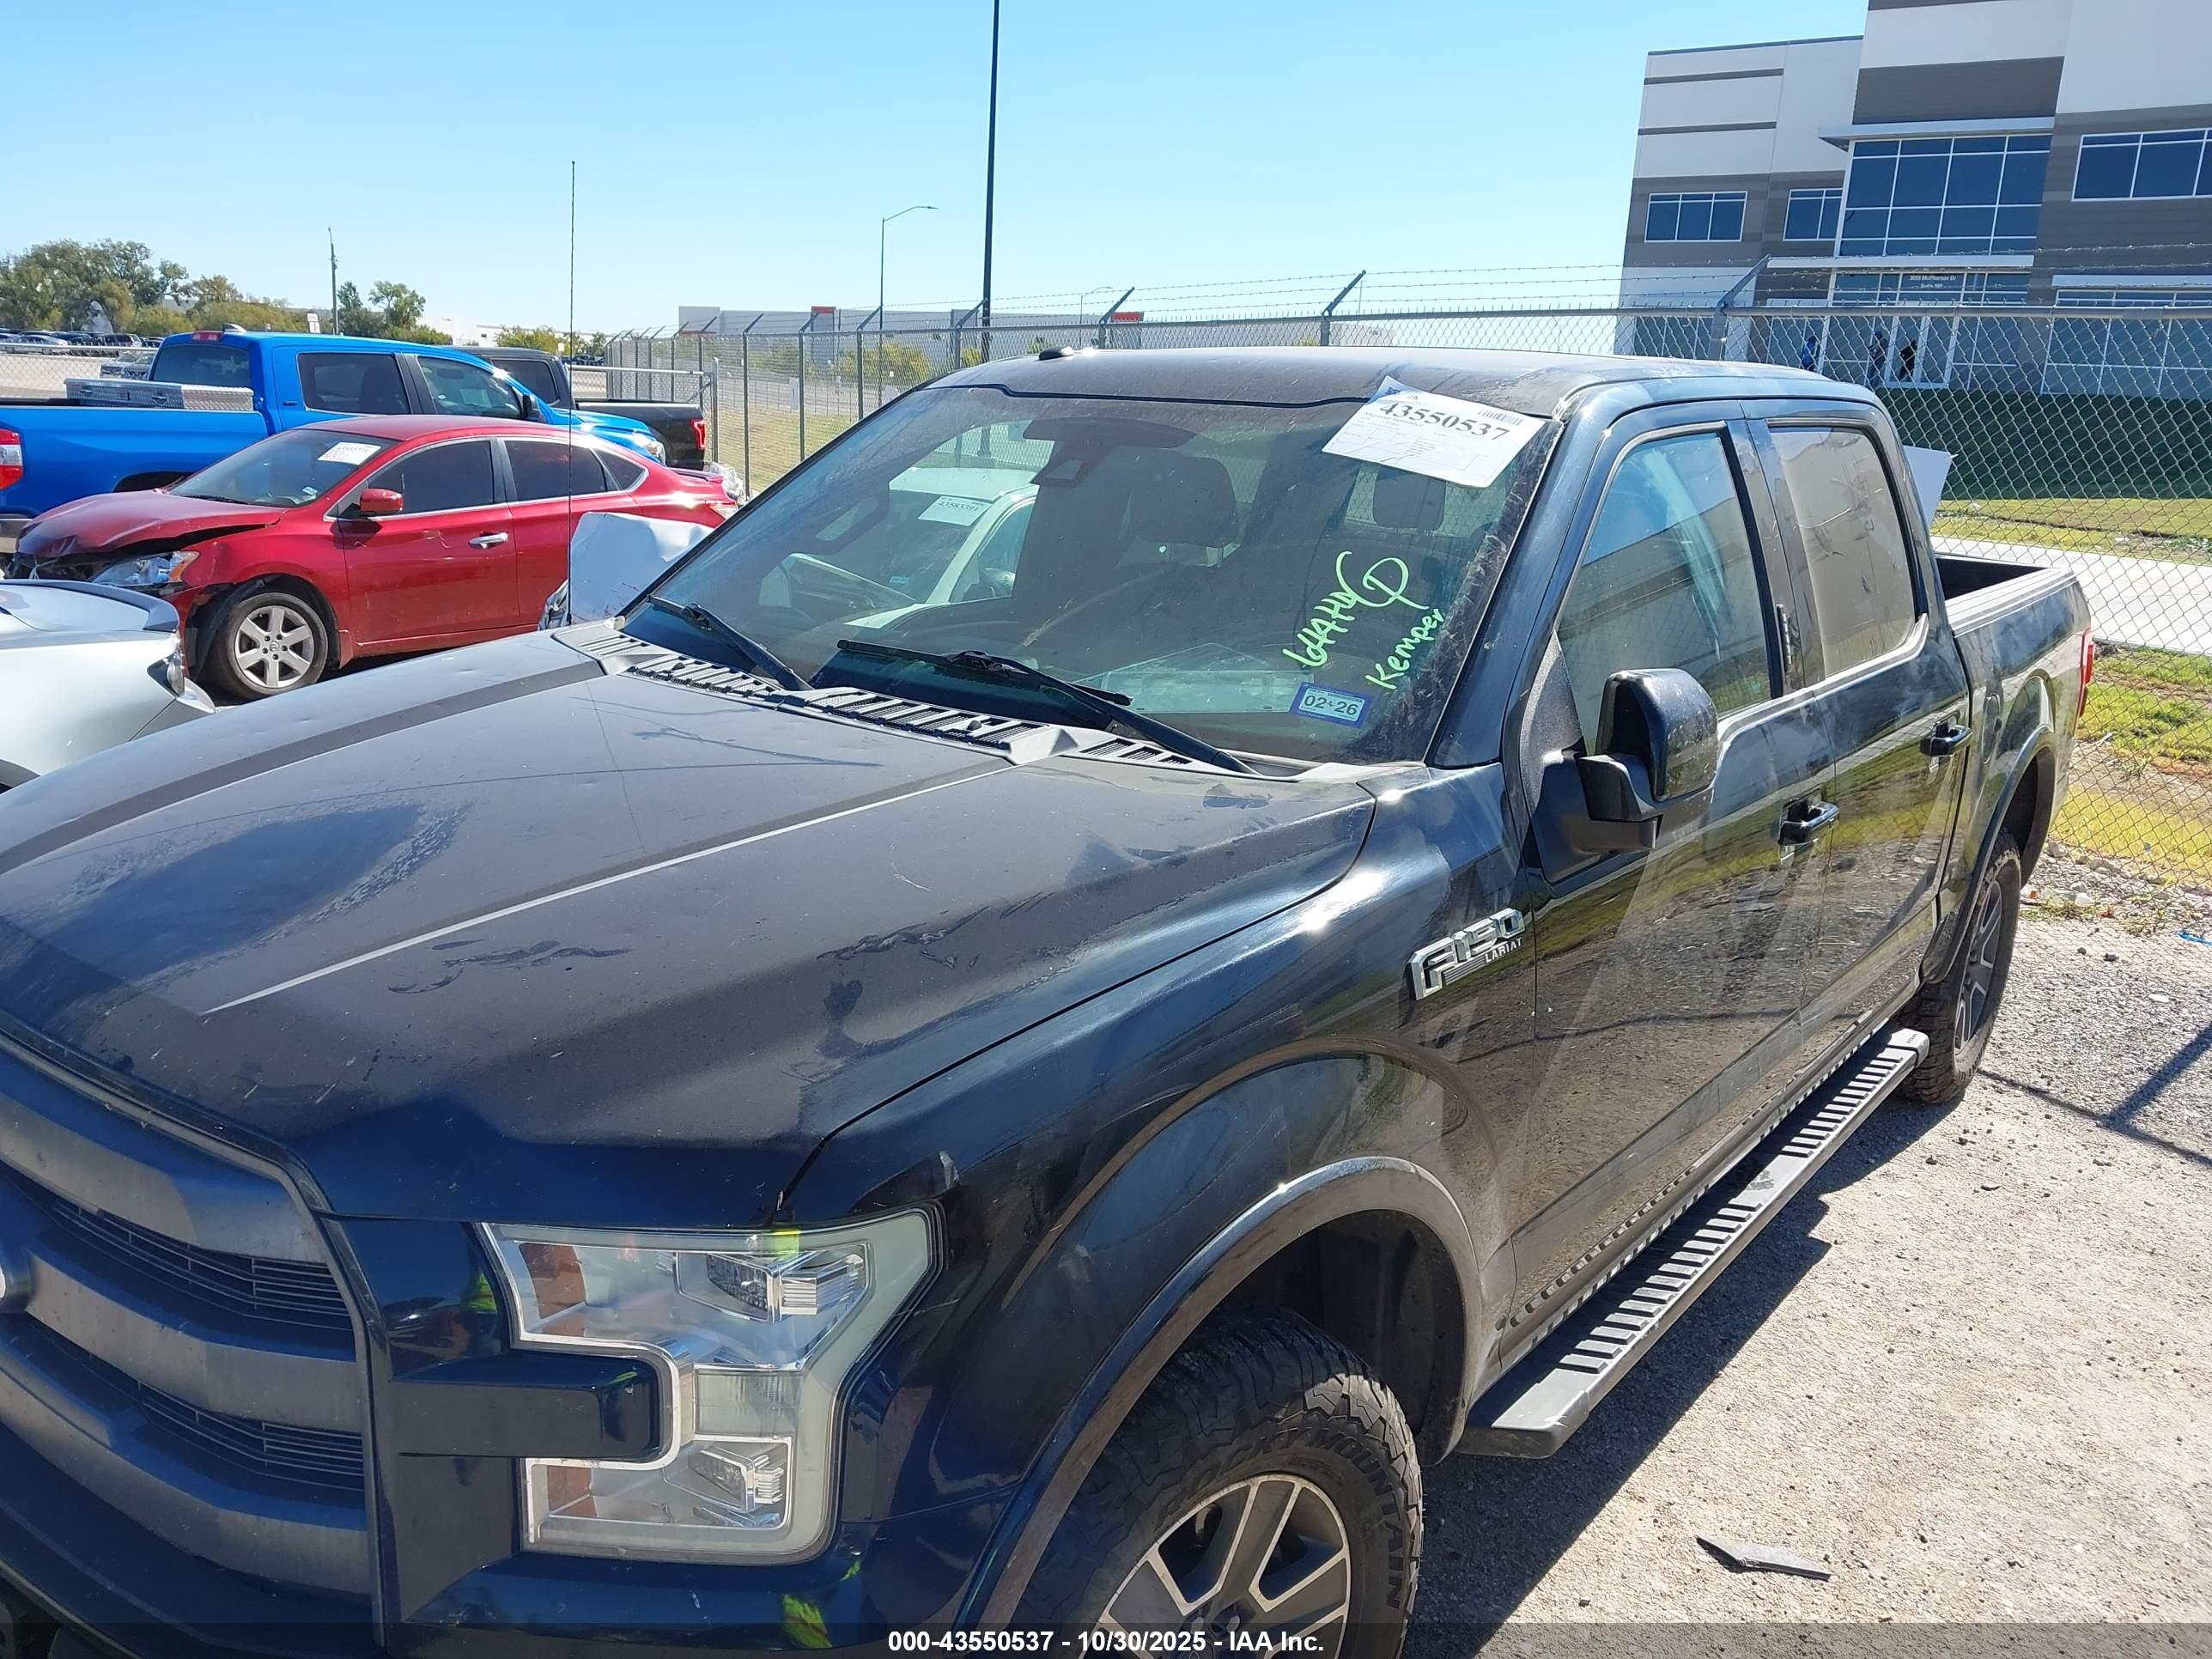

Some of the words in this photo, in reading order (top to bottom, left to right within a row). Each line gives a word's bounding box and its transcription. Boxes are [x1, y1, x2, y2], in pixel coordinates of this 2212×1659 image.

[1379, 401, 1511, 441] 43550537
[1364, 608, 1446, 690] Kemper
[1485, 936, 1523, 963] LARIAT
